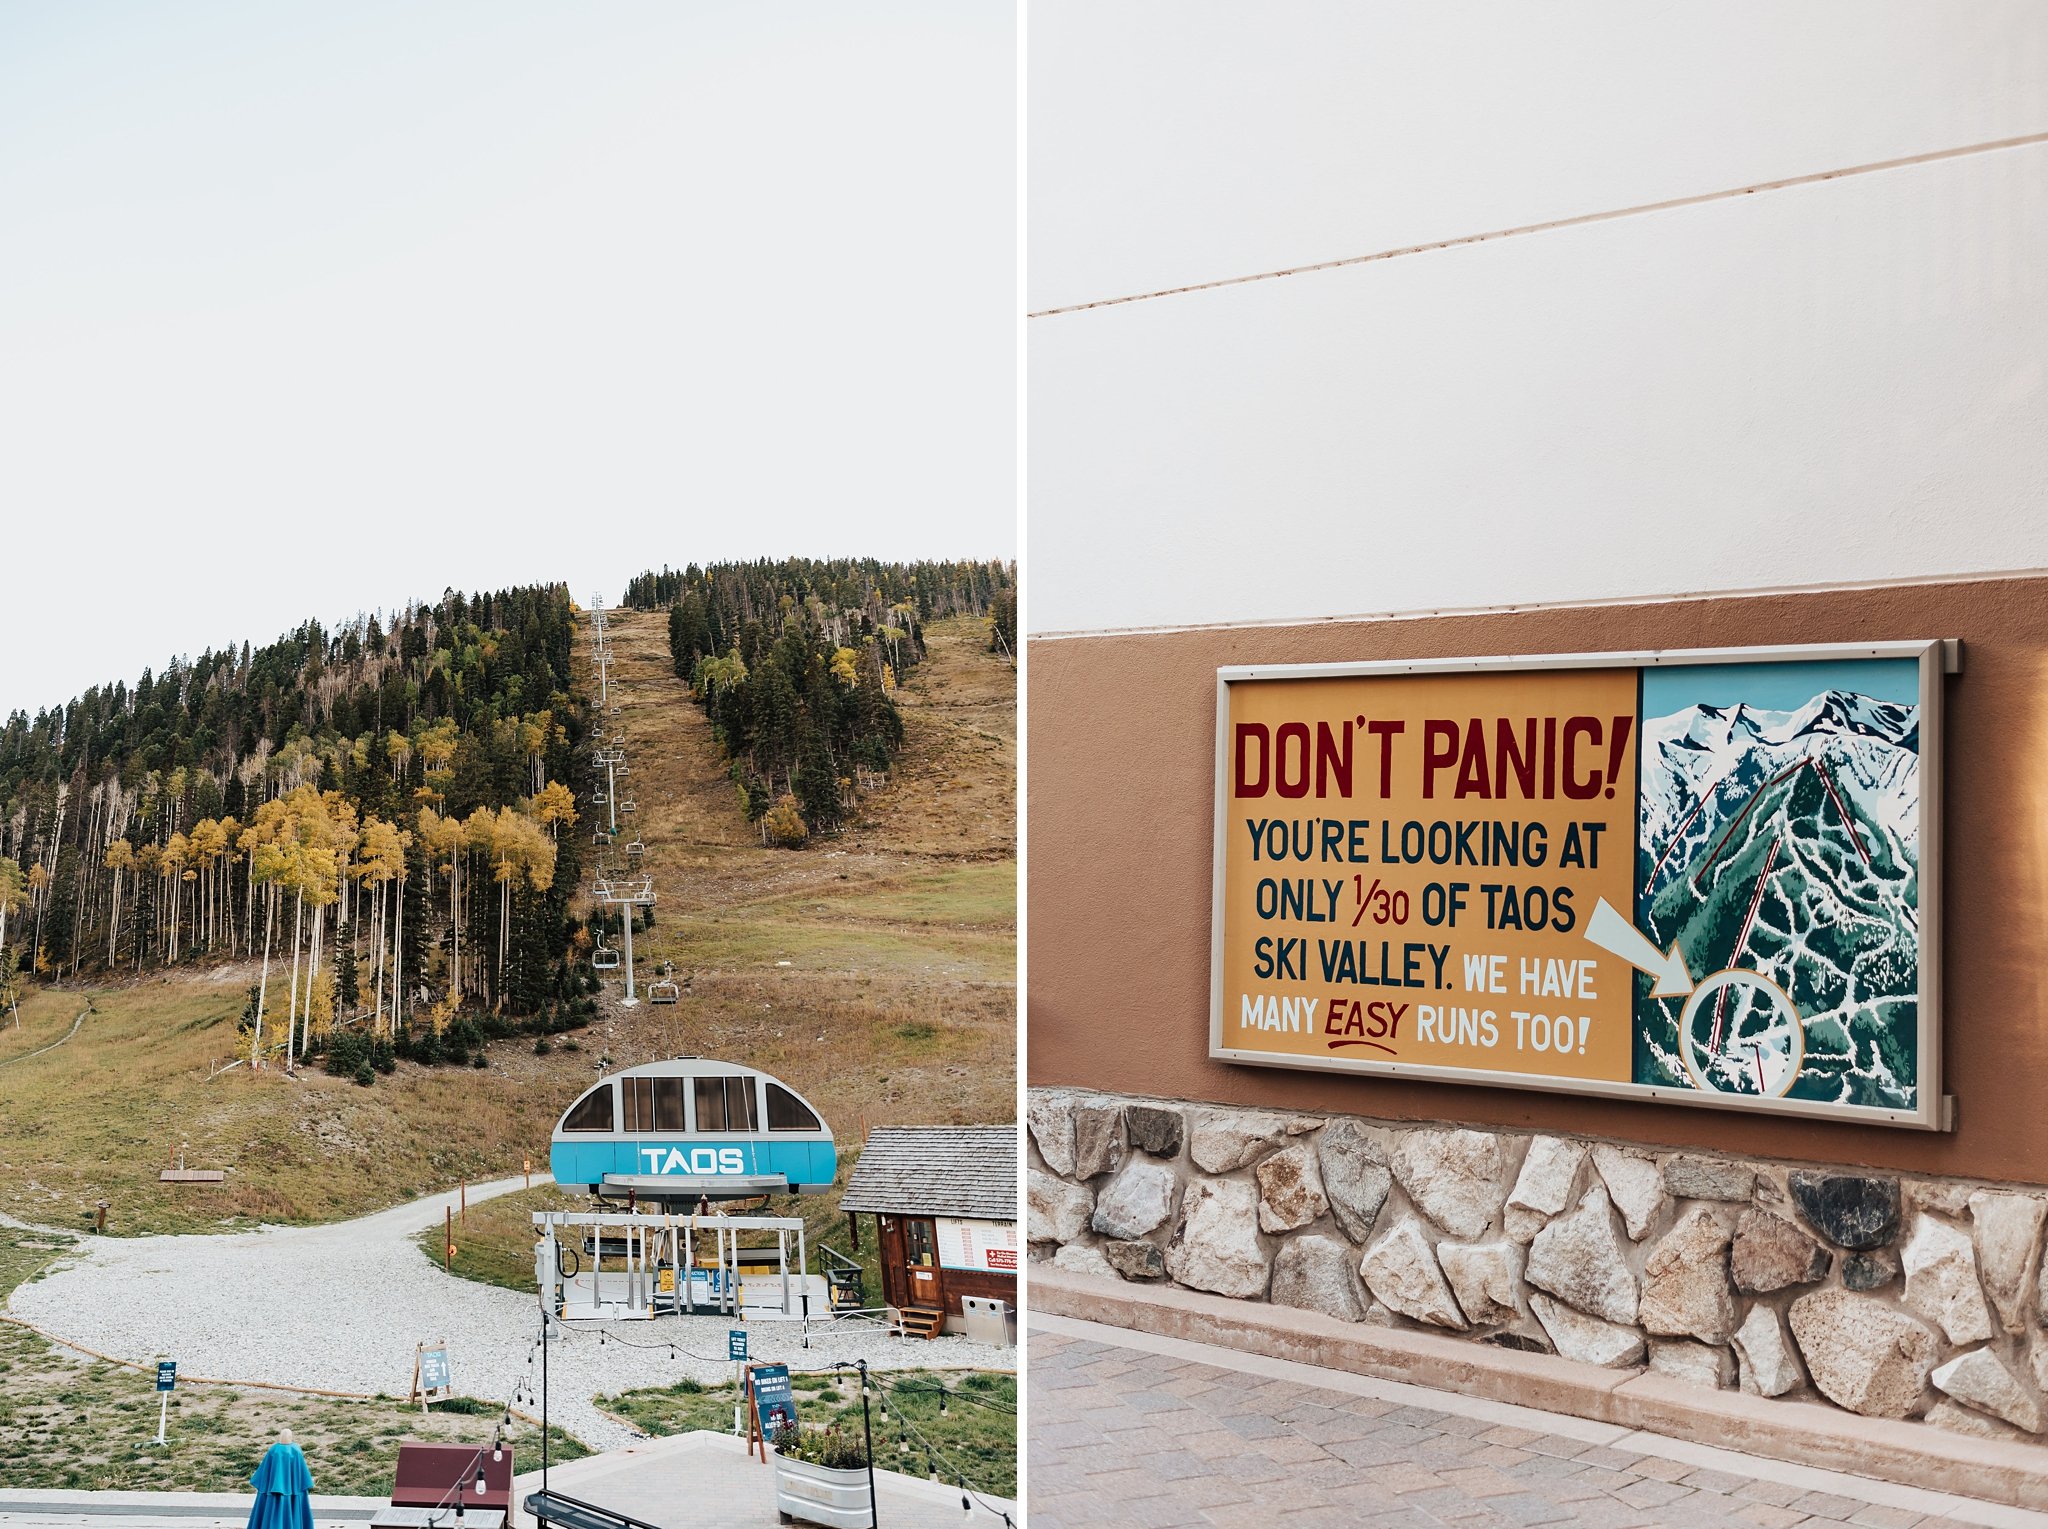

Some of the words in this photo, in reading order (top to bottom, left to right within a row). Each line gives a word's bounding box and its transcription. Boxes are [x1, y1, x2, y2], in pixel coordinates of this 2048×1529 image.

[1235, 715, 1405, 799] DON'T
[1423, 716, 1634, 800] PANIC!
[1246, 818, 1370, 863] YOU'RE
[1382, 821, 1548, 868] LOOKING
[1559, 822, 1607, 870] AT
[1256, 878, 1344, 923] ONLY
[1352, 874, 1410, 927] 1/30
[1422, 883, 1470, 928] OF
[1481, 884, 1576, 934] TAOS
[1254, 937, 1307, 981] SKI
[1318, 939, 1453, 990] VALLEY.
[1463, 954, 1508, 994] WE
[1520, 957, 1597, 1000] HAVE
[1241, 994, 1319, 1034] MANY
[1324, 999, 1410, 1039] EASY
[1418, 1005, 1499, 1048] RUNS
[1511, 1012, 1591, 1055] TOO!
[641, 1147, 744, 1174] TAOS
[992, 1220, 1013, 1228] TERRAIN
